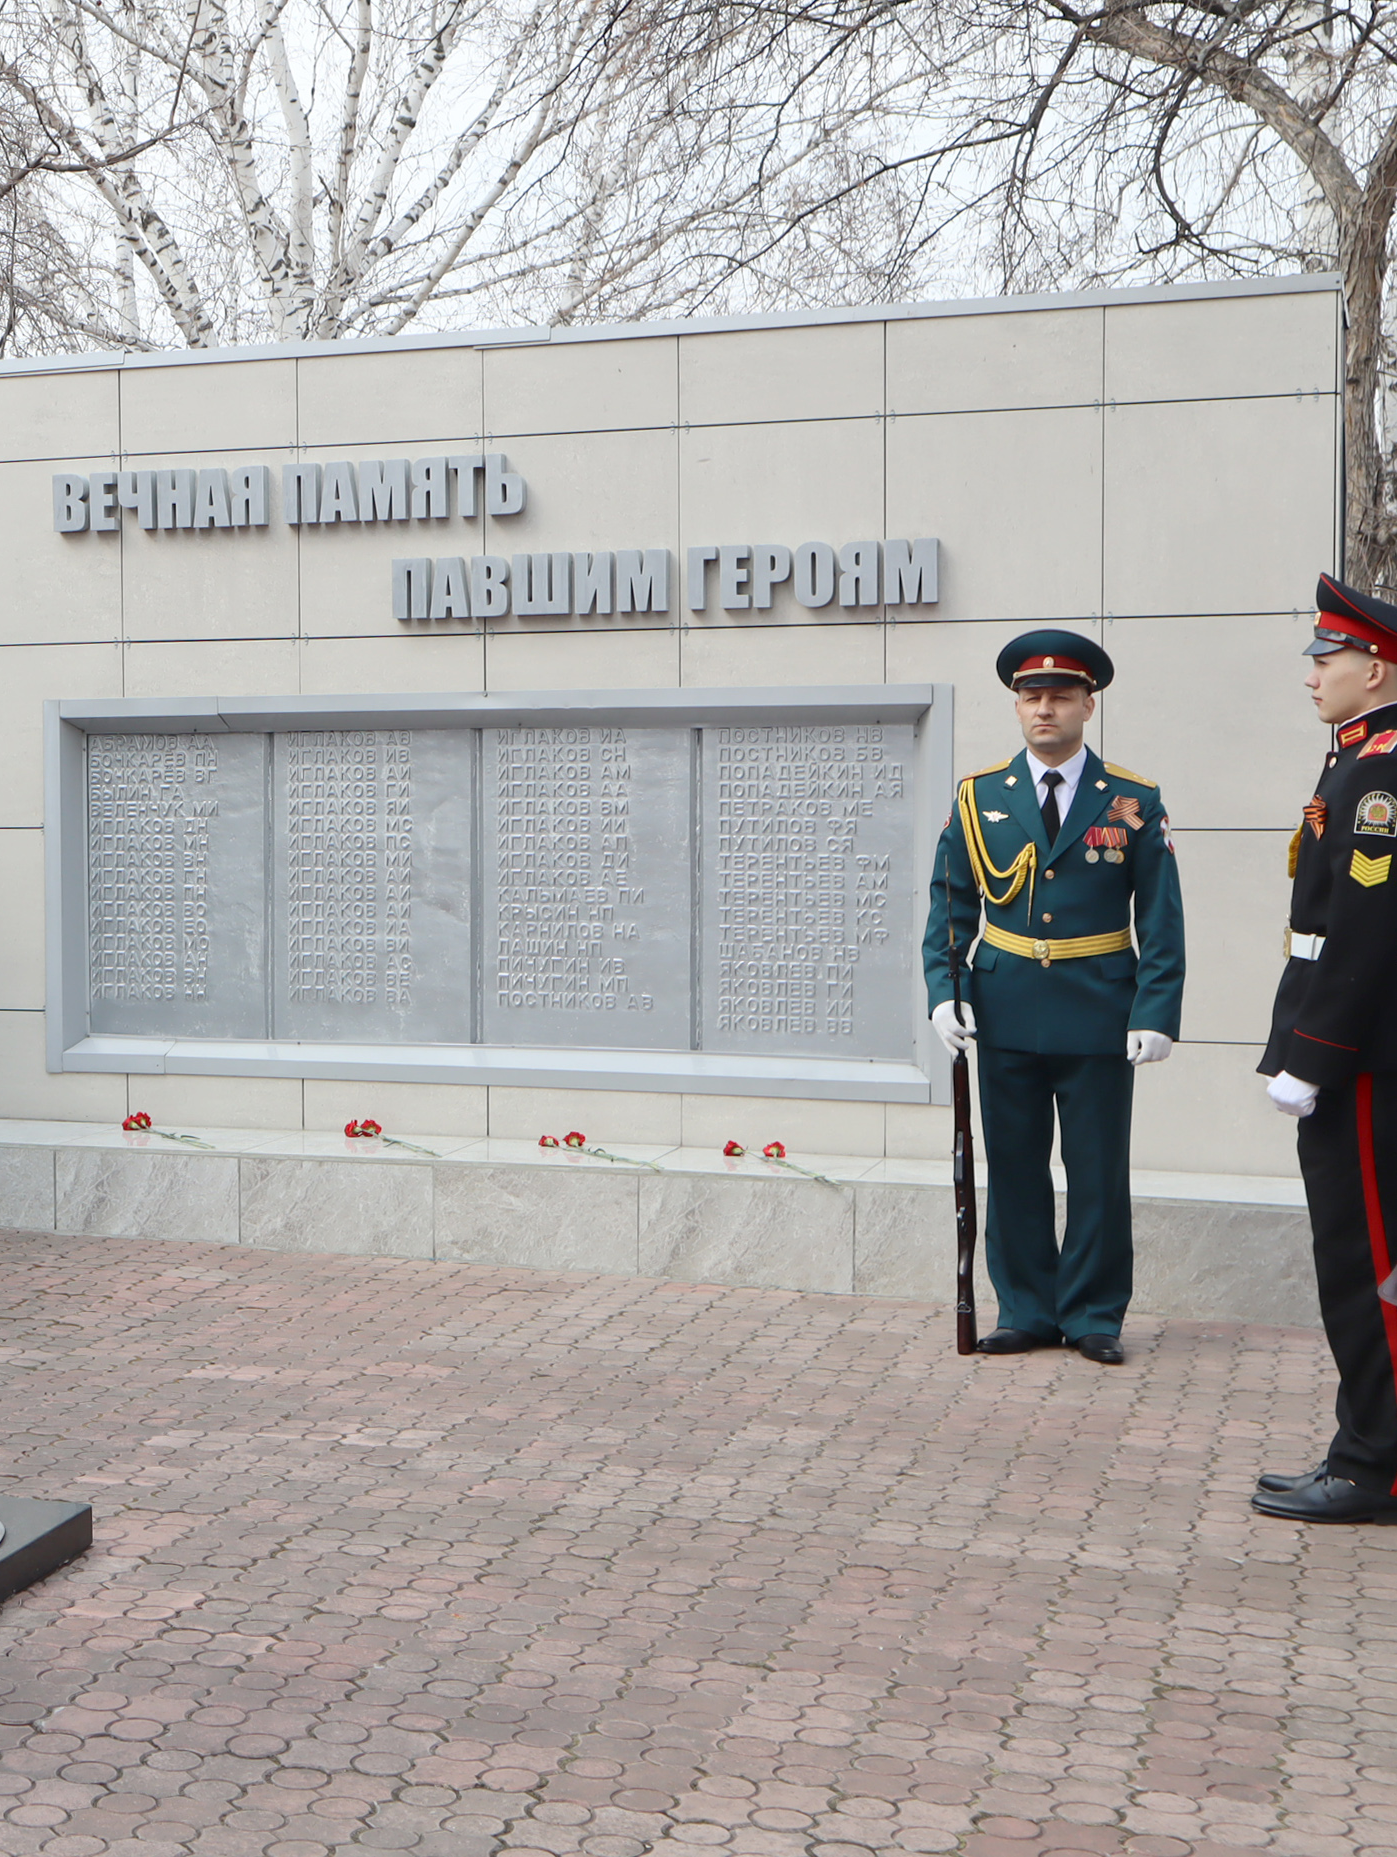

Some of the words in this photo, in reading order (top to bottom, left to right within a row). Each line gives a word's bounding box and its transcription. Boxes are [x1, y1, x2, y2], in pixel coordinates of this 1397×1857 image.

[51, 465, 270, 533] ВЕЧНАЯ
[282, 453, 528, 525] ПАМЯТЬ
[391, 548, 672, 619] ПАВШИМ
[686, 537, 941, 612] ГЕРОЯМ
[90, 735, 180, 750] АБРАМОВ
[188, 735, 214, 750] АА
[288, 731, 377, 747] ИГЛАКОВ
[386, 731, 412, 747] АВ
[498, 728, 591, 745] ИГЛАКОВ
[599, 728, 627, 745] ИА
[719, 727, 845, 744] ПОСТНИКОВ
[856, 727, 883, 744] НВ
[195, 751, 218, 766] ПН
[288, 748, 377, 764] ИГЛАКОВ
[386, 748, 411, 764] ИВ
[498, 746, 591, 763] ИГЛАКОВ
[601, 746, 627, 763] СН
[719, 746, 845, 762] ПОСТНИКОВ
[855, 746, 884, 762] БВ
[195, 767, 218, 783] ВГ
[288, 765, 377, 780] ИГЛАКОВ
[386, 765, 412, 780] АИ
[498, 764, 591, 780] ИГЛАКОВ
[601, 764, 631, 780] АМ
[719, 763, 863, 781] ПОПАДЕЙКИН
[874, 763, 903, 781] ИД
[160, 785, 184, 800] ГА
[288, 782, 377, 798] ИГЛАКОВ
[385, 782, 410, 798] ГИ
[498, 782, 591, 798] ИГЛАКОВ
[601, 782, 628, 798] АА
[719, 781, 863, 799] ПОПАДЕЙКИН
[875, 781, 903, 799] АЯ
[193, 801, 219, 817] МИ
[288, 799, 377, 815] ИГЛАКОВ
[385, 799, 410, 815] ЯИ
[498, 799, 591, 815] ИГЛАКОВ
[601, 799, 630, 815] ВМ
[719, 799, 832, 816] ПЕТРАКОВ
[843, 799, 873, 816] МЕ
[90, 818, 175, 834] ИГЛАКОВ
[288, 816, 377, 832] ИГЛАКОВ
[385, 816, 413, 832] МС
[498, 816, 591, 833] ИГЛАКОВ
[601, 816, 626, 833] ИИ
[719, 817, 816, 834] ПУТИЛОВ
[826, 817, 858, 834] ФЯ
[90, 835, 175, 851] ИГЛАКОВ
[183, 835, 209, 851] МН
[288, 833, 377, 849] ИГЛАКОВ
[385, 833, 411, 849] ПС
[498, 834, 591, 850] ИГЛАКОВ
[601, 834, 628, 850] АП
[719, 835, 817, 852] ПУТИЛОВ
[826, 835, 853, 852] СЯ
[90, 851, 175, 867] ИГЛАКОВ
[184, 851, 208, 867] ВН
[288, 850, 377, 866] ИГЛАКОВ
[385, 850, 413, 866] МИ
[498, 852, 591, 869] ИГЛАКОВ
[601, 852, 630, 869] ДИ
[719, 854, 845, 871] ТЕРЕНТЬЕВ
[856, 854, 890, 871] ФМ
[91, 868, 175, 884] ИГЛАКОВ
[184, 868, 207, 884] ГН
[288, 867, 377, 883] ИГЛАКОВ
[386, 867, 411, 883] АИ
[498, 869, 591, 886] ИГЛАКОВ
[601, 869, 628, 886] АЕ
[719, 871, 845, 889] ТЕРЕНТЬЕВ
[856, 871, 888, 889] АМ
[91, 885, 175, 900] ИГЛАКОВ
[184, 885, 207, 900] ПН
[288, 884, 377, 900] ИГЛАКОВ
[386, 884, 411, 900] АИ
[498, 886, 608, 904] КАЛЬМАЕВ
[618, 886, 644, 904] ПИ
[719, 889, 845, 907] ТЕРЕНТЬЕВ
[856, 891, 887, 908] МС
[91, 901, 176, 917] ИГЛАКОВ
[184, 901, 207, 917] ВО
[288, 901, 377, 918] ИГЛАКОВ
[386, 901, 411, 918] АИ
[498, 904, 579, 921] КРЫСИН
[589, 904, 614, 921] НП
[719, 907, 845, 925] ТЕРЕНТЬЕВ
[856, 909, 884, 926] КС
[91, 917, 176, 934] ИГЛАКОВ
[184, 917, 208, 934] ЕО
[288, 918, 377, 935] ИГЛАКОВ
[385, 918, 411, 935] ИА
[498, 921, 604, 939] КАРНИЛОВ
[613, 921, 640, 939] НА
[91, 934, 176, 950] ИГЛАКОВ
[184, 934, 210, 950] МО
[288, 935, 377, 952] ИГЛАКОВ
[385, 935, 410, 952] ВИ
[719, 925, 845, 943] ТЕРЕНТЬЕВ
[856, 927, 889, 945] МФ
[577, 938, 602, 955] НП
[719, 943, 823, 961] ШАБАНОВ
[833, 945, 861, 962] НВ
[91, 951, 176, 967] ИГЛАКОВ
[184, 951, 208, 967] АН
[288, 952, 377, 969] ИГЛАКОВ
[386, 952, 412, 969] АС
[497, 956, 590, 974] ПИЧУГИН
[600, 956, 625, 974] ИВ
[91, 967, 176, 983] ИГЛАКОВ
[184, 967, 207, 983] ВН
[288, 969, 377, 986] ИГЛАКОВ
[385, 969, 411, 986] ВЕ
[718, 961, 816, 979] ЯКОВЛЕВ
[826, 963, 853, 980] ПИ
[497, 973, 590, 991] ПИЧУГИН
[600, 973, 628, 991] МП
[718, 978, 816, 997] ЯКОВЛЕВ
[826, 981, 853, 998] ГИ
[91, 984, 176, 1000] ИГЛАКОВ
[288, 986, 377, 1003] ИГЛАКОВ
[385, 986, 411, 1003] ВА
[497, 990, 617, 1009] ПОСТНИКОВ
[628, 993, 654, 1010] АВ
[717, 996, 816, 1015] ЯКОВЛЕВ
[826, 999, 853, 1016] ИИ
[717, 1015, 816, 1033] ЯКОВЛЕВ
[826, 1017, 853, 1034] ВВ
